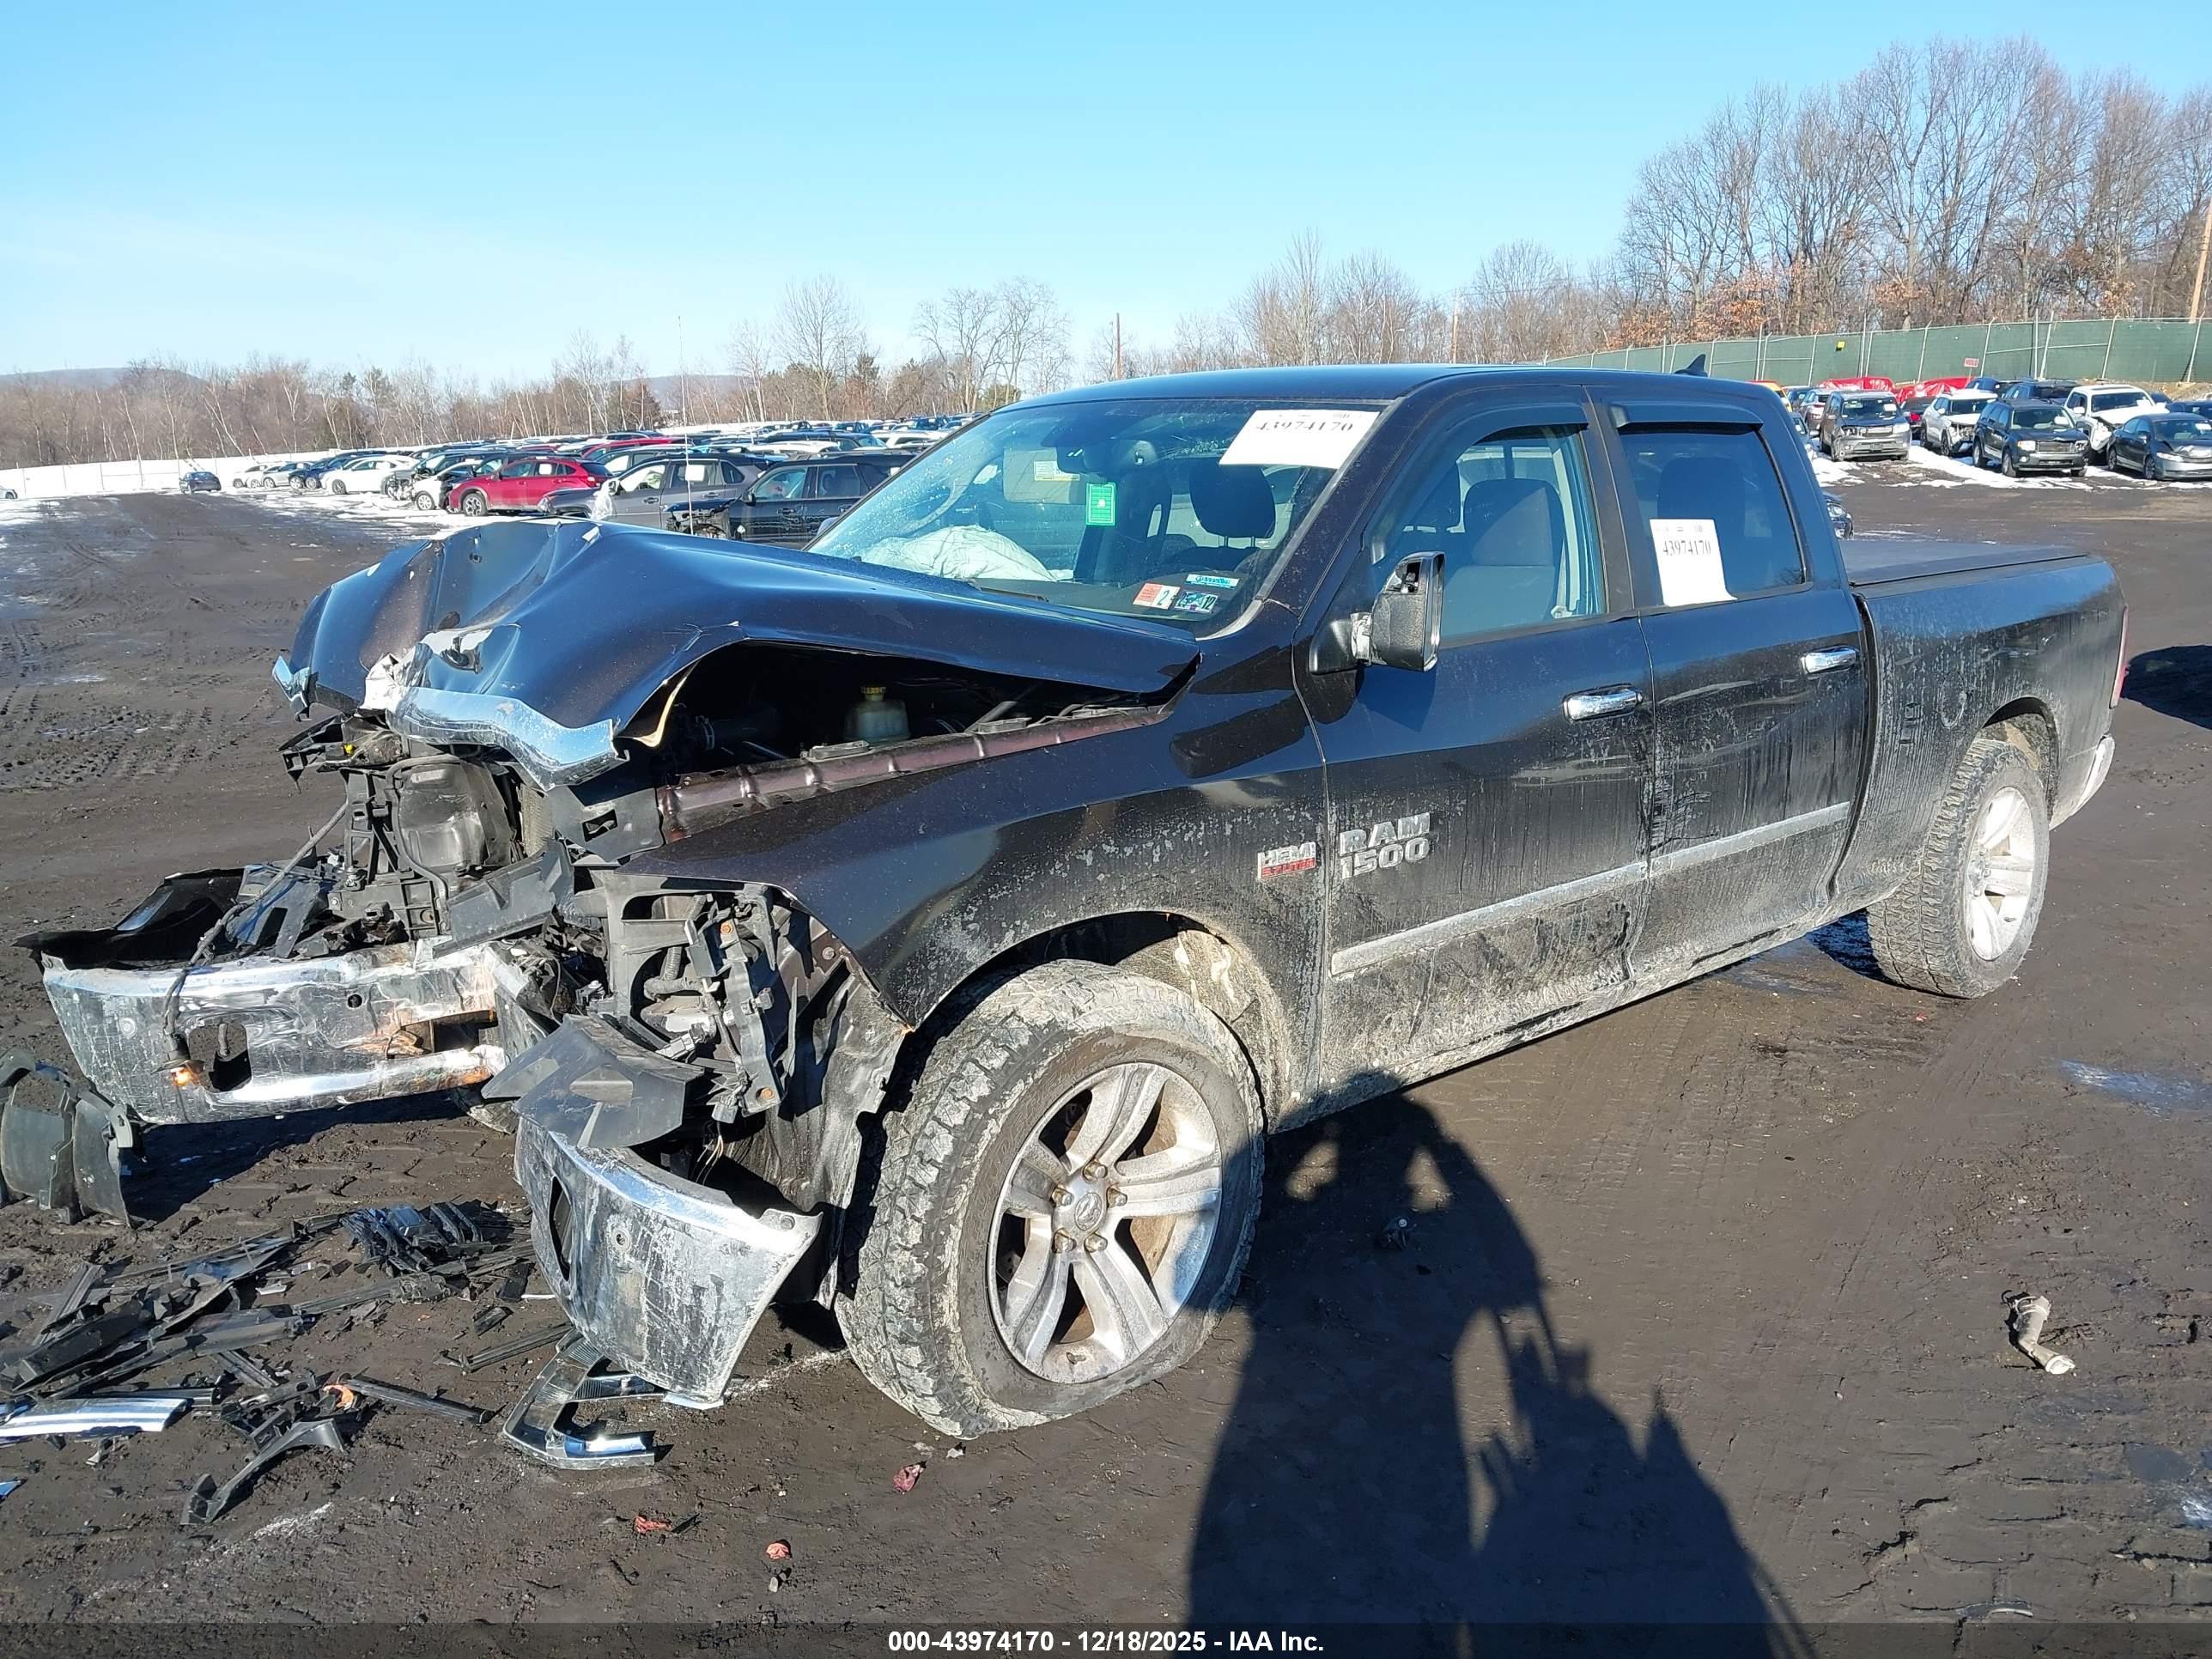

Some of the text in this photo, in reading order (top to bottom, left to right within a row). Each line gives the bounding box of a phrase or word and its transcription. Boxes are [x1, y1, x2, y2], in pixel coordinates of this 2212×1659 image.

[1255, 420, 1354, 431] 43974170
[1663, 538, 1711, 556] 43974170
[1201, 595, 1216, 610] 12
[1340, 812, 1431, 854] RAM
[1340, 837, 1431, 880] 1500
